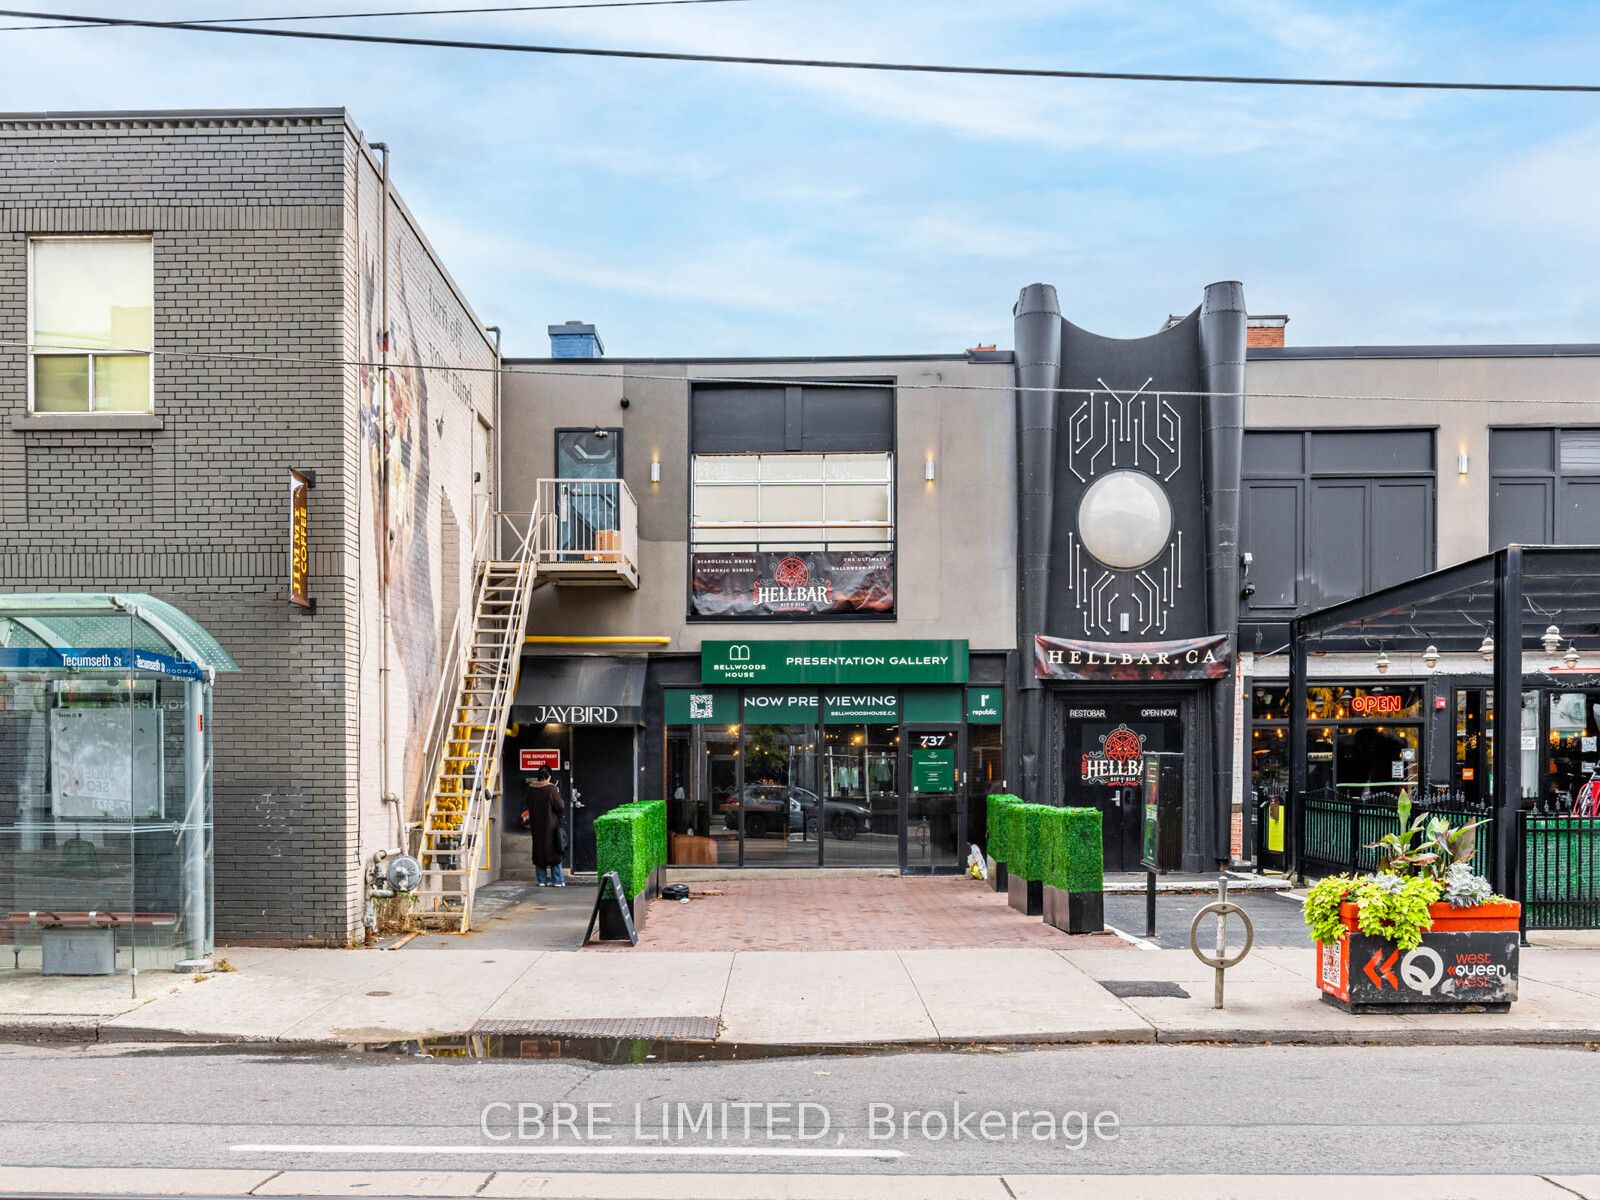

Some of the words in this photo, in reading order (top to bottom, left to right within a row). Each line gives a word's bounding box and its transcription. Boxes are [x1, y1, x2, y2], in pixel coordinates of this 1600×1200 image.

[300, 507, 308, 574] COFFEE
[753, 586, 832, 606] HELLBAR
[62, 654, 111, 667] Tecumseth
[113, 655, 122, 667] St
[136, 655, 161, 671] Tecumseth
[786, 657, 884, 666] PRESENTATION
[889, 656, 949, 666] GALLERY
[1048, 649, 1218, 666] HELLBAR.CA
[744, 696, 784, 707] NOW
[788, 696, 819, 707] PRE
[825, 695, 897, 706] VIEWING
[1351, 695, 1402, 712] OPEN
[535, 706, 618, 723] JAYBIRD
[1069, 709, 1106, 718] RESTOBAR
[1141, 709, 1159, 717] OPEN
[1160, 709, 1177, 717] NOW
[920, 736, 946, 746] 737
[1455, 953, 1491, 964] west
